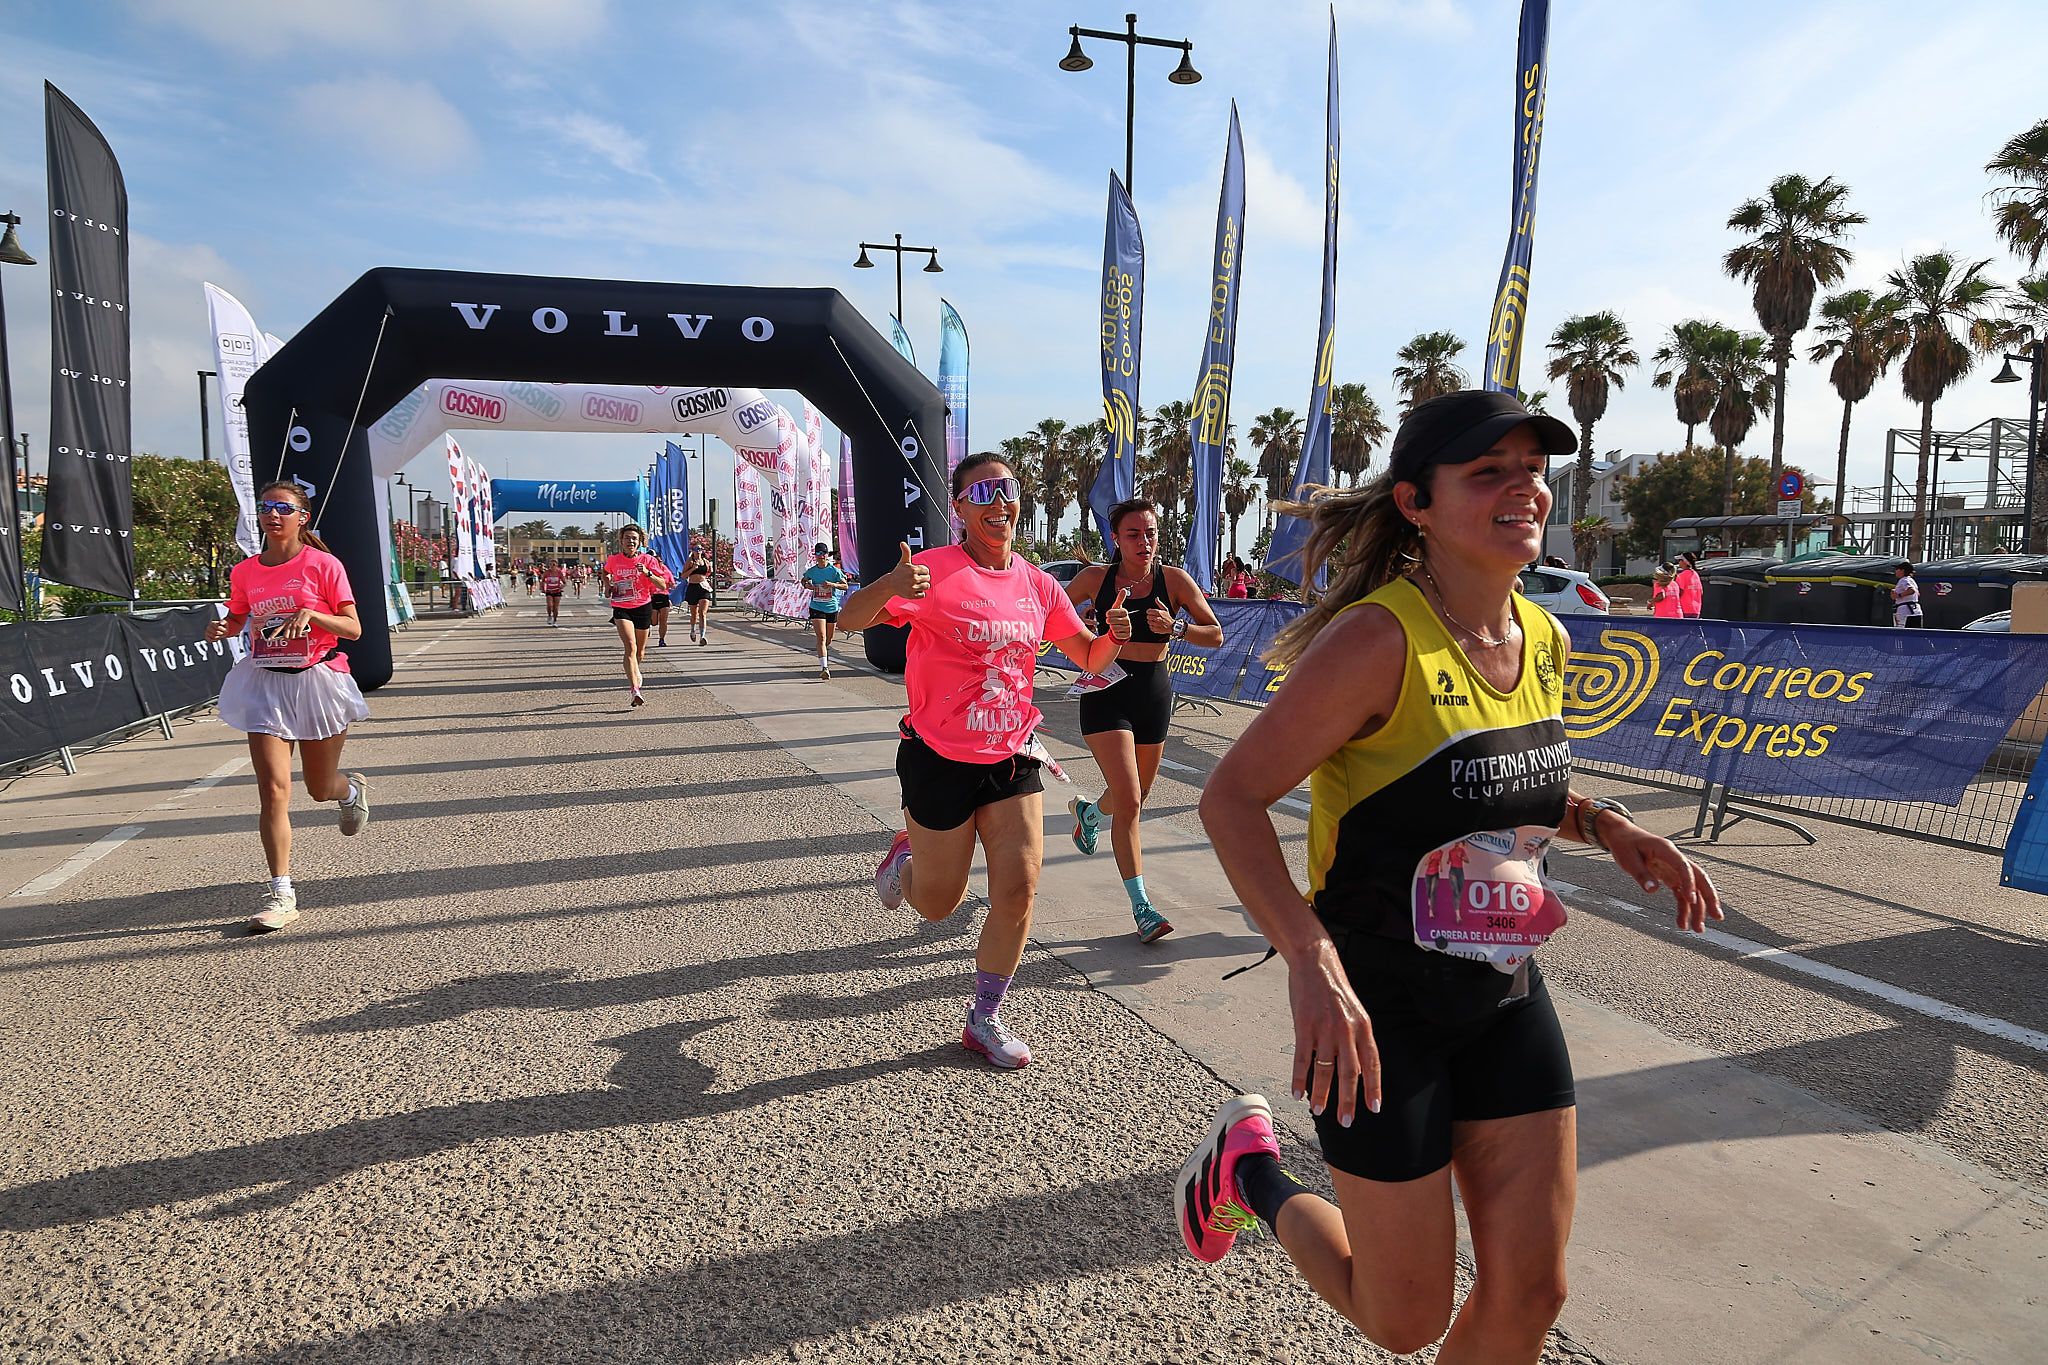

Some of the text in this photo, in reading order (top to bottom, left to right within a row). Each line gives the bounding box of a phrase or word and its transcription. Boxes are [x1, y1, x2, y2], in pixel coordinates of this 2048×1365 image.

[451, 302, 775, 342] VOLVO
[446, 390, 501, 420] COSMO
[587, 396, 639, 423] COSMO
[677, 388, 727, 418] COSMO
[738, 400, 777, 429] COSM
[901, 436, 924, 549] LVO
[961, 600, 995, 610] OYSHO
[967, 621, 1036, 643] CARRERA
[140, 637, 224, 672] VOLVO
[1166, 650, 1207, 678] xpress
[10, 653, 124, 703] OLVO
[1683, 650, 1874, 704] Correos
[1430, 694, 1470, 706] VIATOR
[966, 706, 1023, 732] MUJER
[1654, 698, 1839, 759] Express
[1451, 751, 1527, 783] PATERNA
[1452, 783, 1505, 799] CLUB
[1468, 881, 1530, 912] 016
[1430, 929, 1469, 940] CARRERA
[1470, 932, 1481, 941] DE
[1483, 932, 1494, 941] LA
[1496, 932, 1523, 943] MUJER
[1487, 916, 1516, 929] 3406
